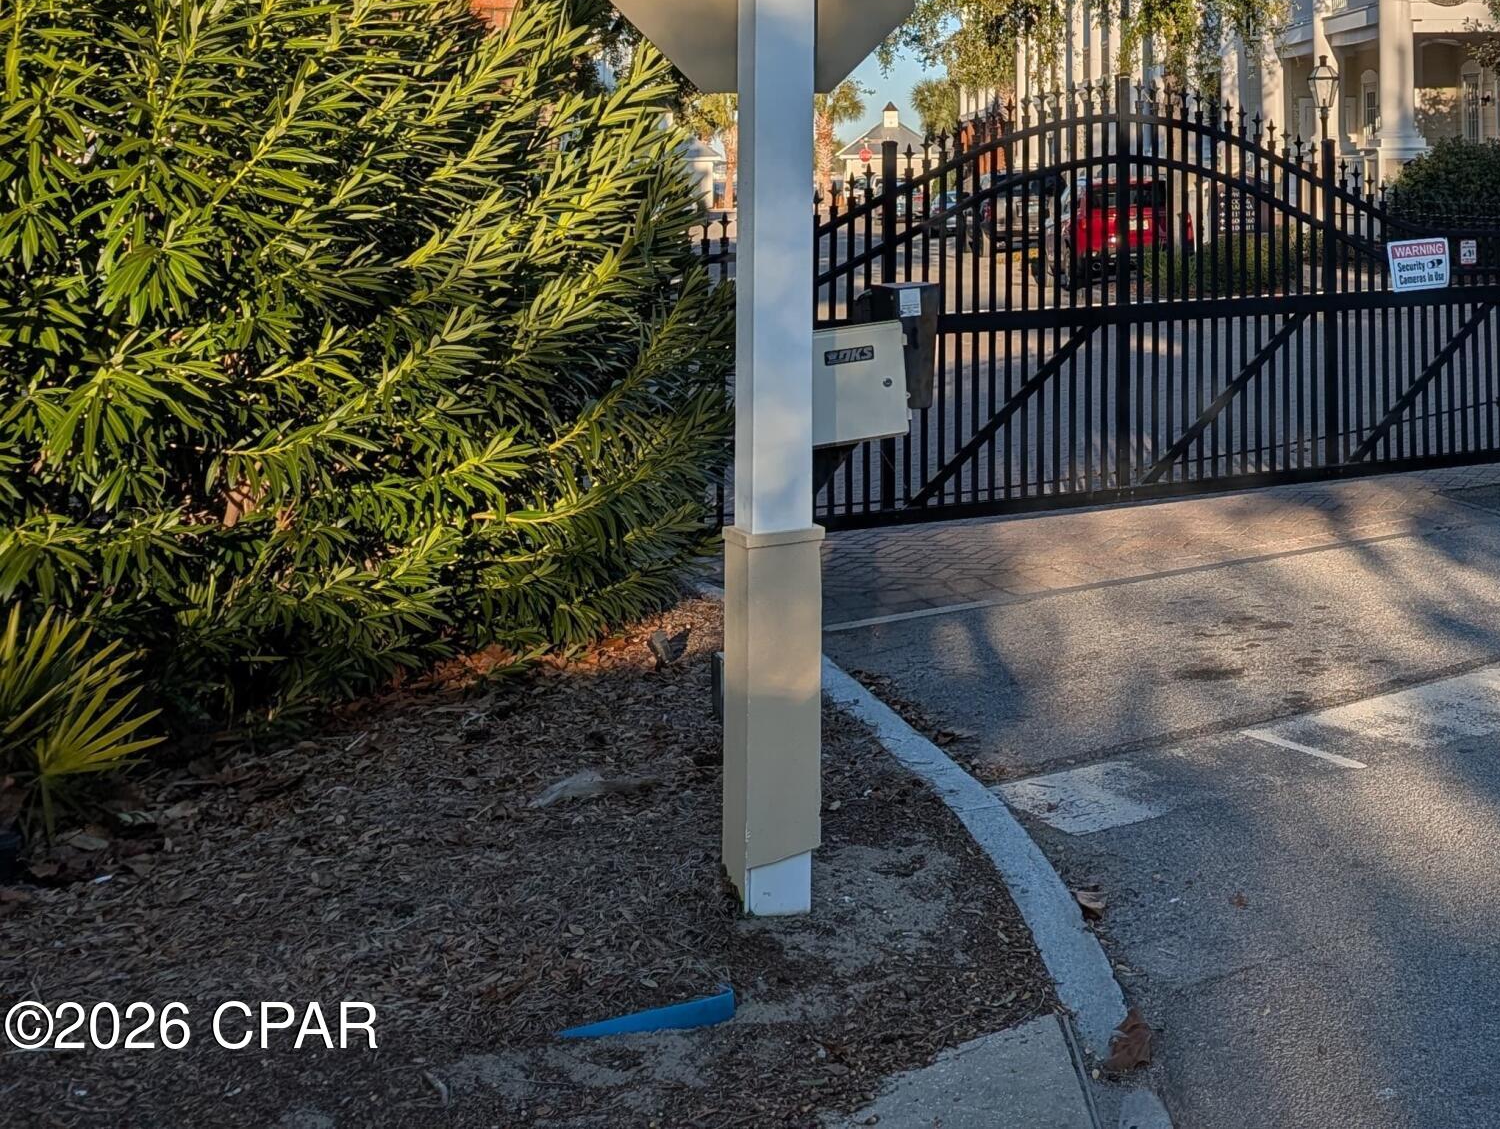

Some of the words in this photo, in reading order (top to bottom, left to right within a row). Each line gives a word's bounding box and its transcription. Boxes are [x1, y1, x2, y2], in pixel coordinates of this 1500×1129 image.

[1394, 243, 1444, 258] WARNING
[1397, 260, 1426, 273] Security
[1399, 274, 1426, 285] Cameras
[1427, 272, 1434, 282] In
[1434, 271, 1444, 281] Use
[838, 346, 873, 361] DKS
